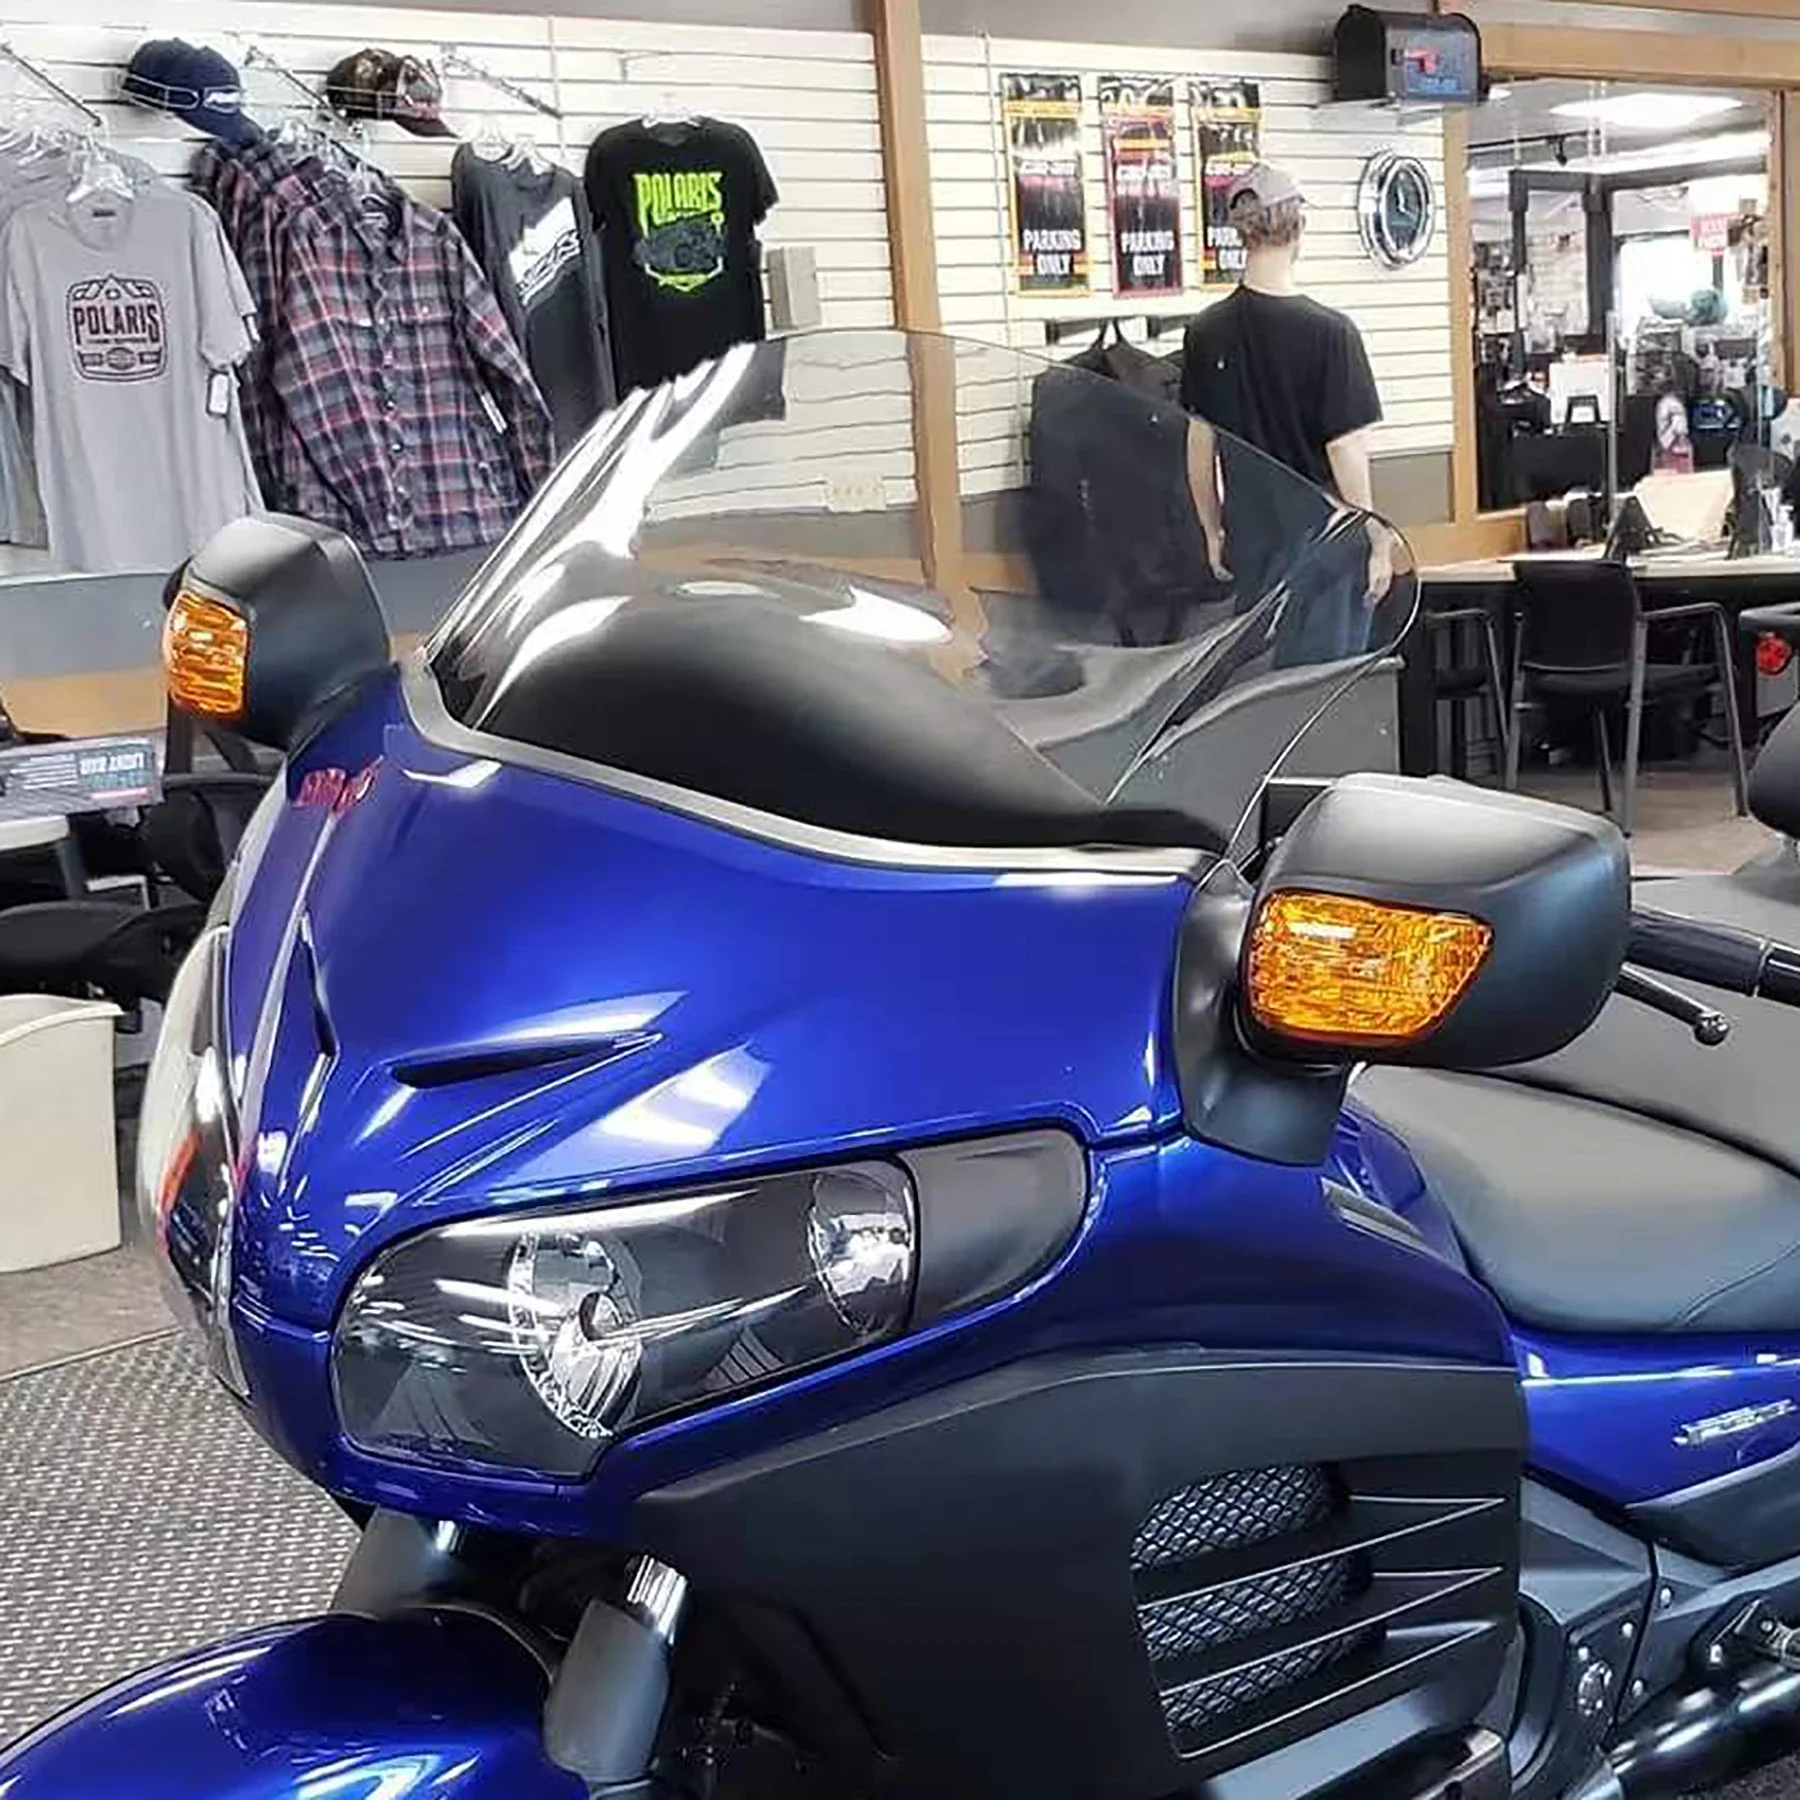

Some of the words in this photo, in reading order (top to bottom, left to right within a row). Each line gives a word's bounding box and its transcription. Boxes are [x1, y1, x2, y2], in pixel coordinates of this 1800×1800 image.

[632, 172, 723, 238] POLARIS
[1022, 228, 1081, 251] PARKING
[1120, 230, 1174, 252] PARKING
[1036, 253, 1072, 275] ONLY
[1132, 254, 1166, 275] ONLY
[73, 303, 160, 345] POLARIS
